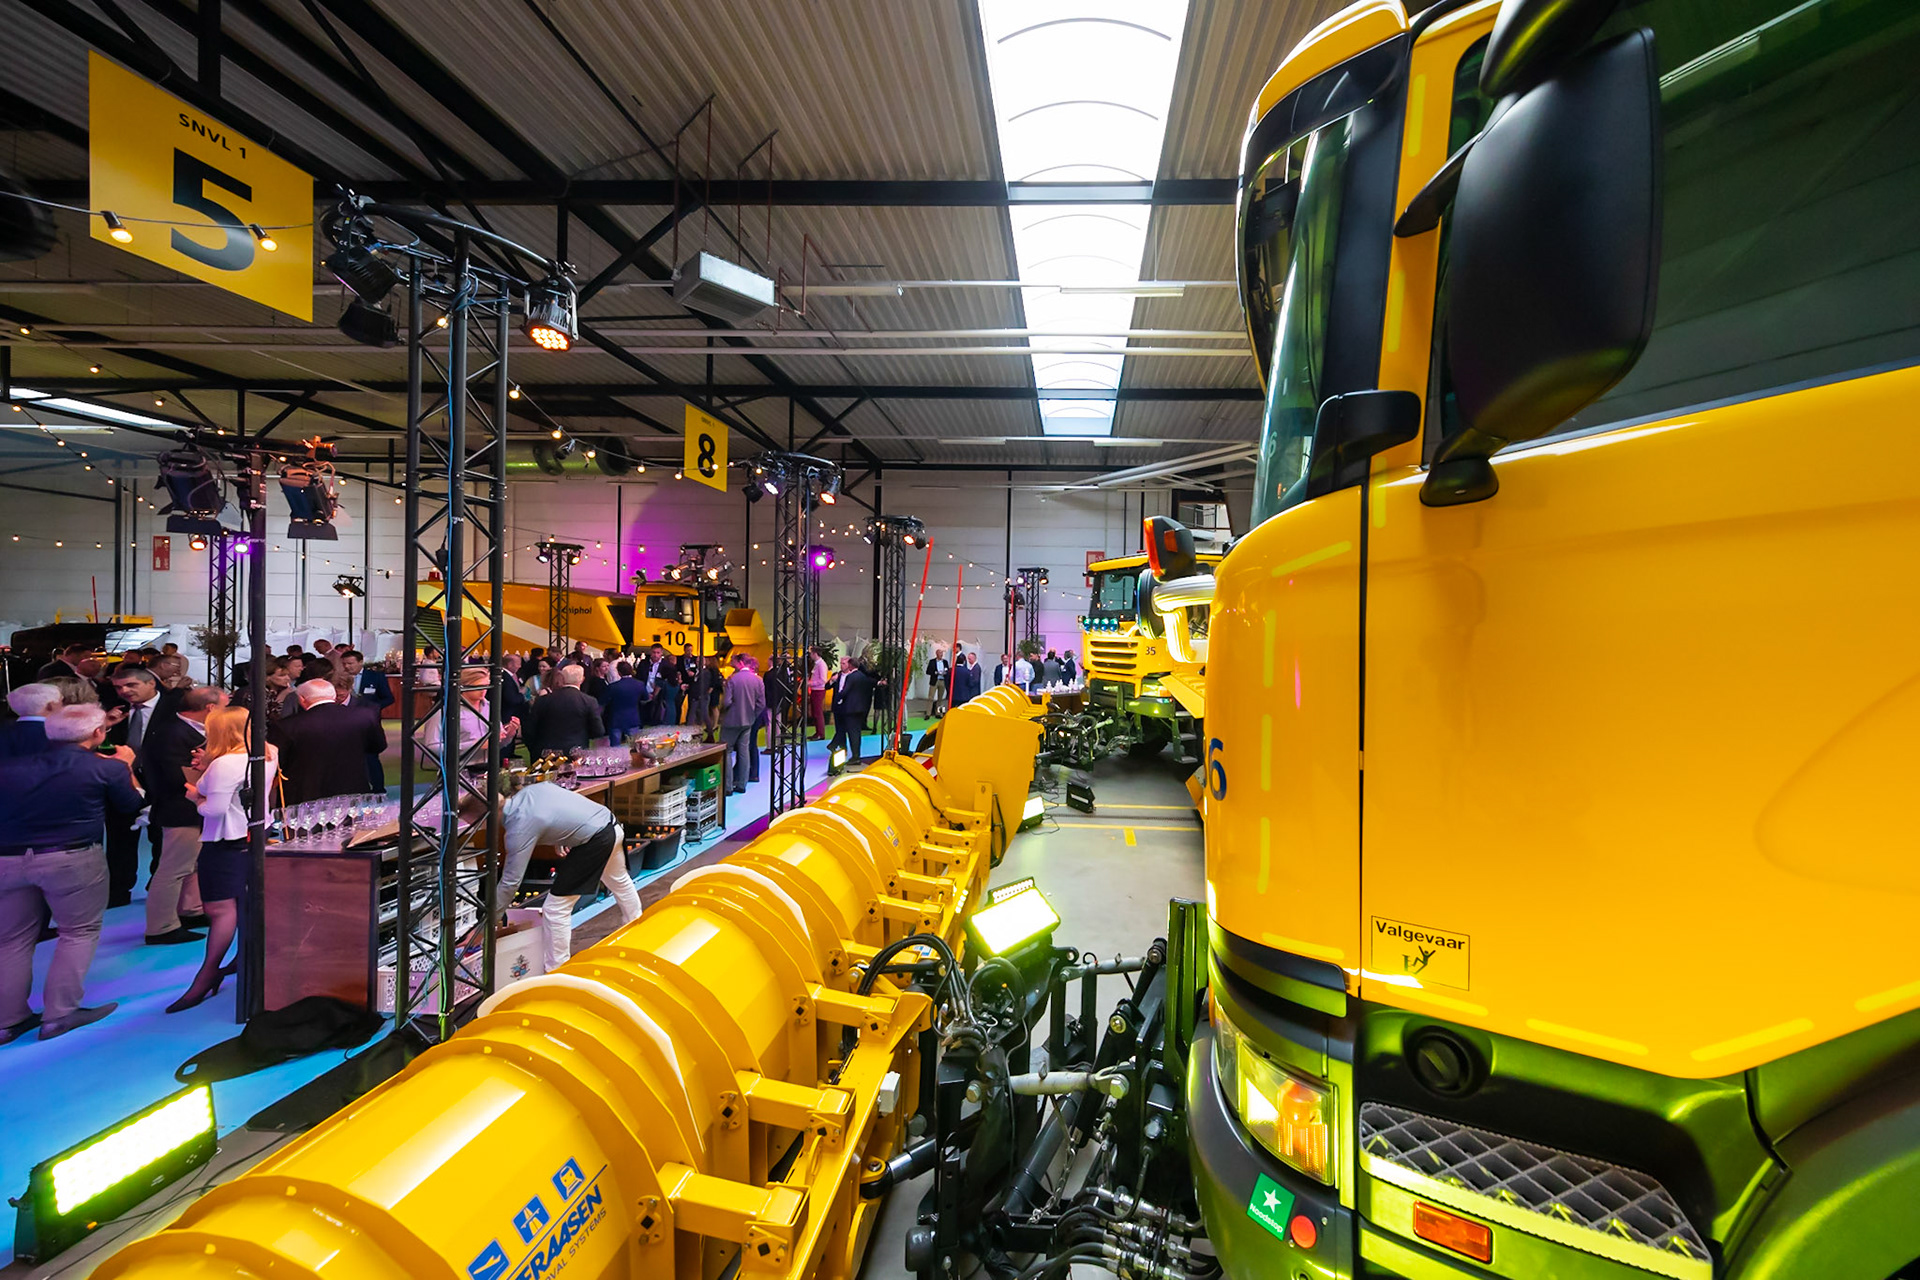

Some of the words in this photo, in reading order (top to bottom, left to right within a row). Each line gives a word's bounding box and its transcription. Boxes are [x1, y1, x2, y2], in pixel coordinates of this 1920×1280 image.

[179, 113, 231, 151] SNVL
[239, 147, 246, 159] 1
[171, 147, 255, 271] 5
[698, 433, 716, 478] 8
[664, 630, 686, 646] 10
[1145, 646, 1156, 656] 35
[1203, 737, 1227, 801] 6
[1376, 920, 1465, 950] Valgevaar
[569, 1206, 607, 1258] SYSTEMS
[1249, 1203, 1283, 1233] Noodstop
